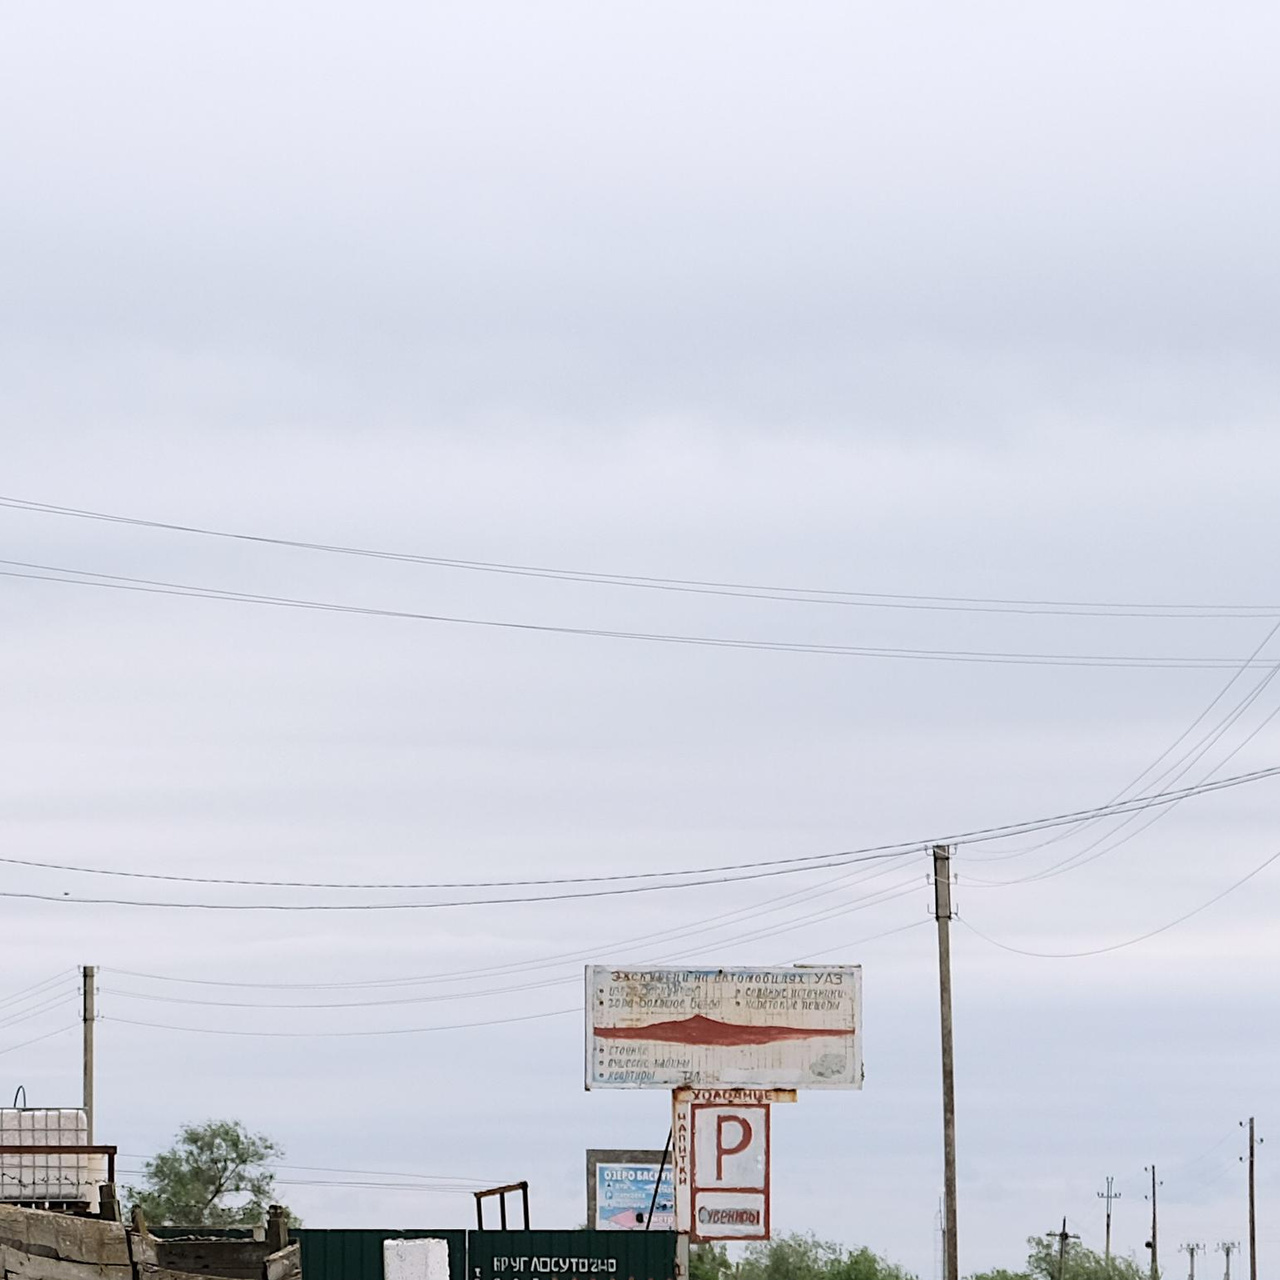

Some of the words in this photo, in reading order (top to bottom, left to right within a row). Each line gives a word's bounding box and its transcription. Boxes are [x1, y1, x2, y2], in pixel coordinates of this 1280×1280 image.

[814, 972, 843, 985] УАЗ
[677, 1112, 687, 1186] НАПИТКИ
[716, 1114, 753, 1181] P
[604, 1170, 636, 1181] ОЗЕРО
